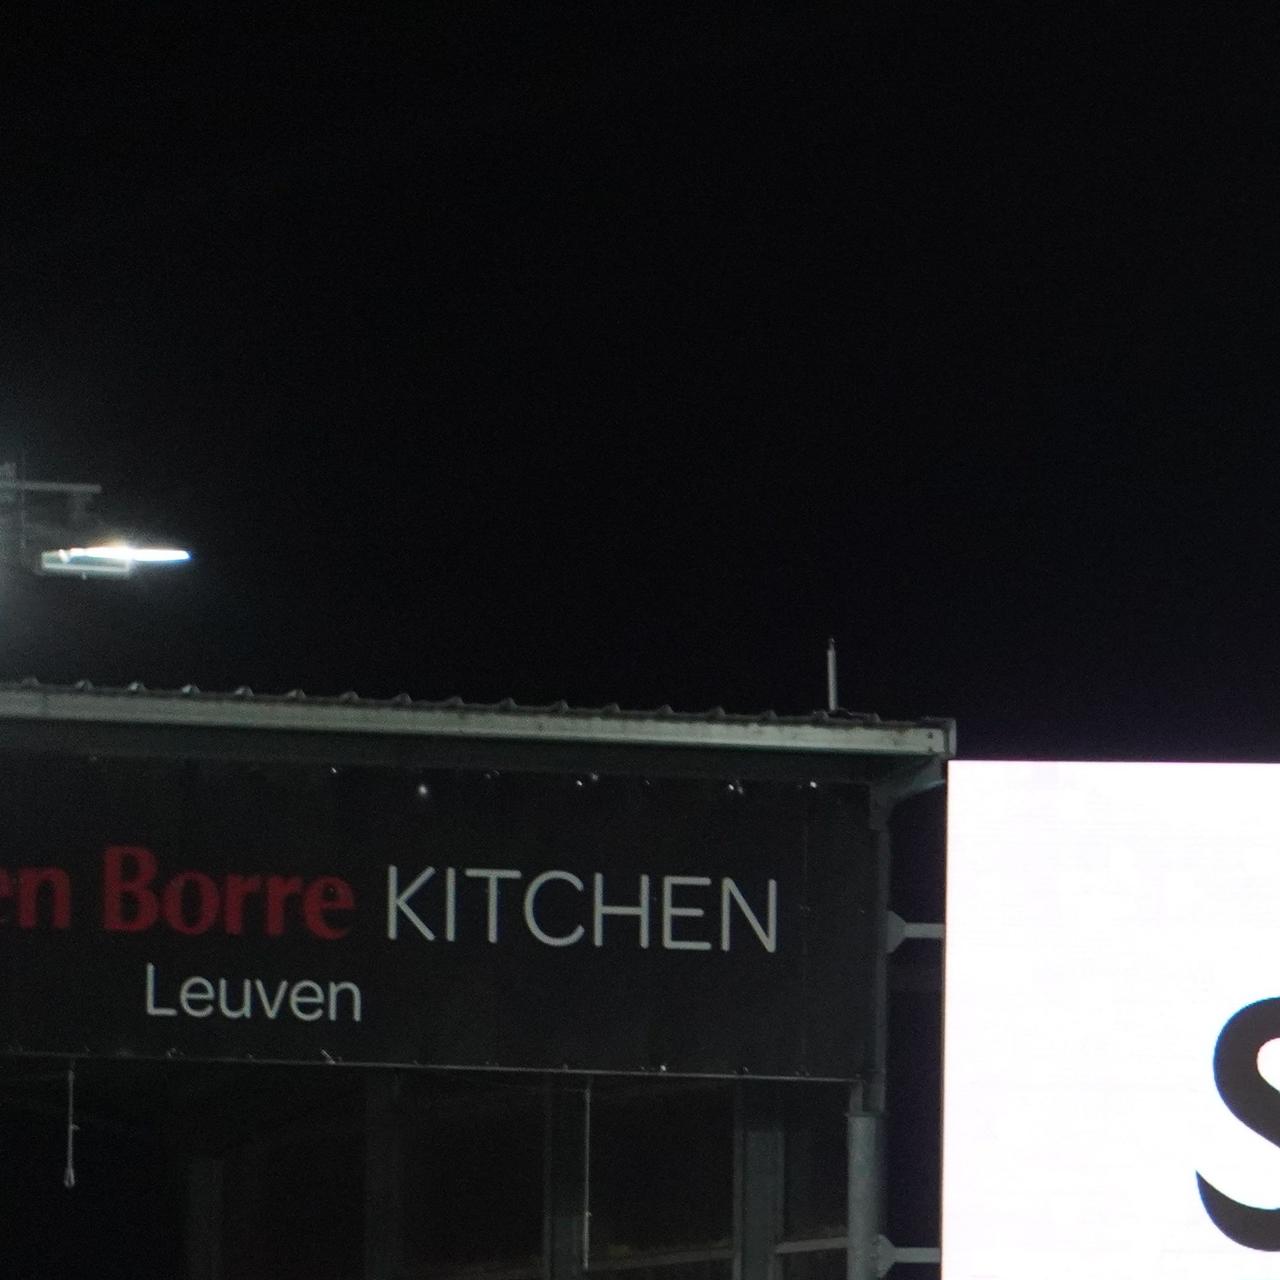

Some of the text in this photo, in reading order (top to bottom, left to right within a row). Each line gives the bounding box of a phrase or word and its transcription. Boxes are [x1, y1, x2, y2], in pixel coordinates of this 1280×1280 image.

[104, 847, 353, 938] Borre
[388, 865, 777, 953] KITCHEN
[146, 964, 361, 1022] Leuven
